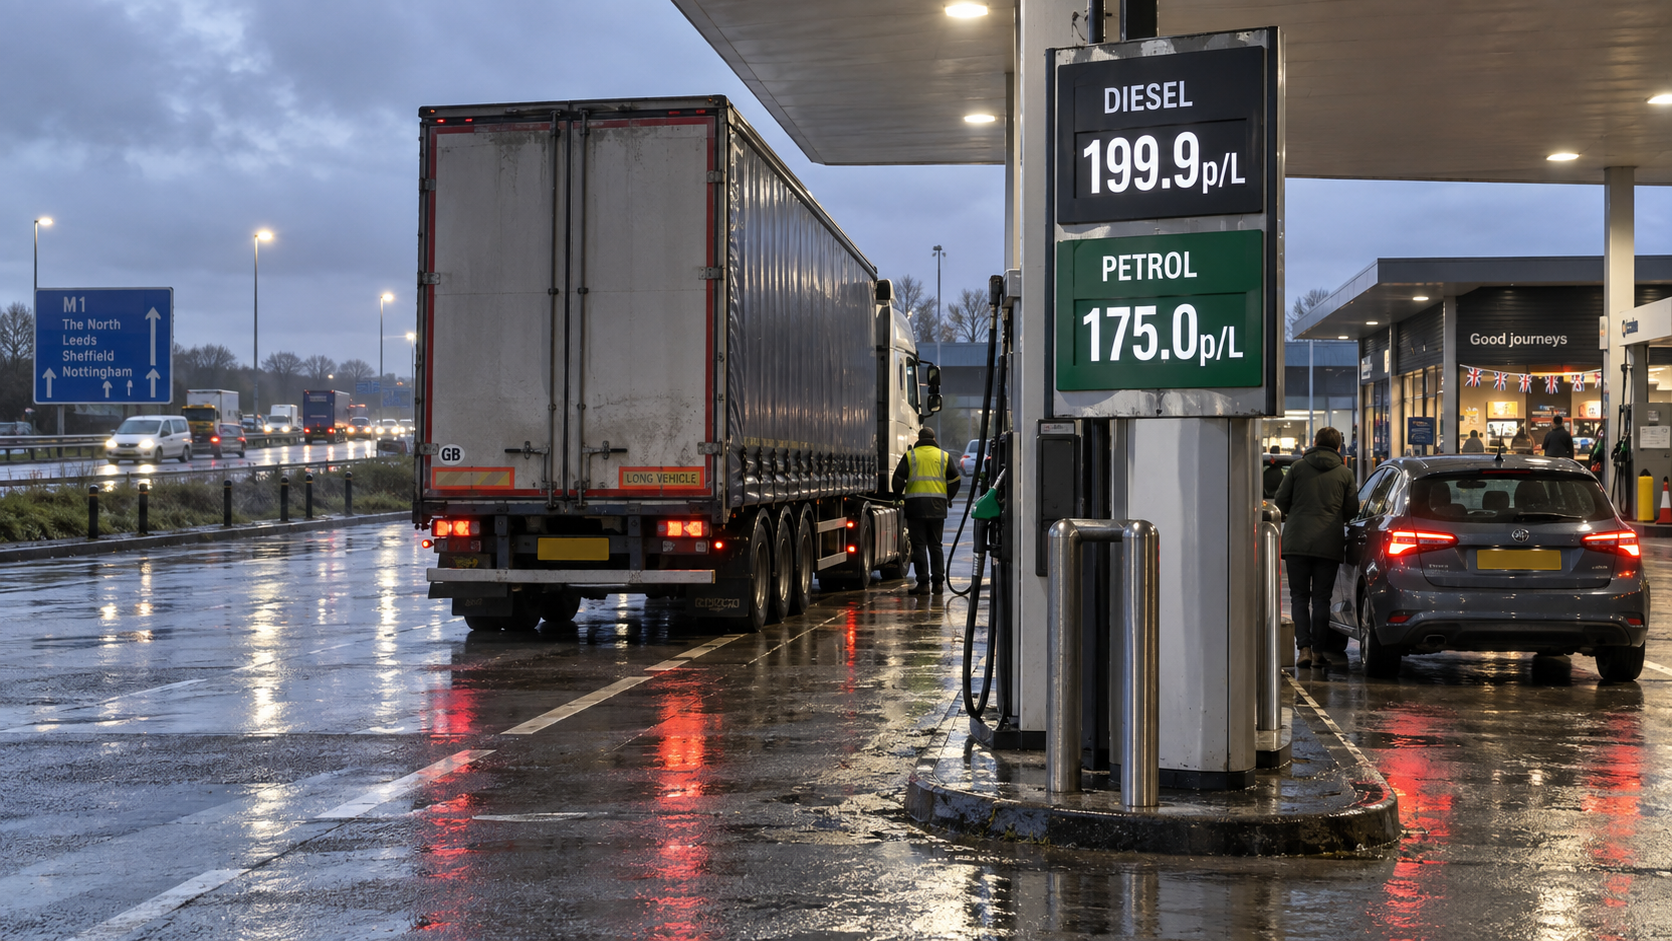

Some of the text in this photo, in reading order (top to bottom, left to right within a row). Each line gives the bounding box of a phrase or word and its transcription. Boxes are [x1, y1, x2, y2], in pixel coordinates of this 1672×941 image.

[1104, 80, 1193, 114] DIESEL
[1102, 251, 1198, 282] PETROL
[63, 296, 86, 313] M1
[62, 318, 121, 330] The North
[62, 334, 97, 346] Leeds
[1470, 332, 1568, 349] Good journeys
[62, 350, 115, 362] Sheffield
[62, 365, 133, 380] Nottingham
[441, 446, 461, 462] GB
[626, 473, 696, 484] LONG VEHICLE
